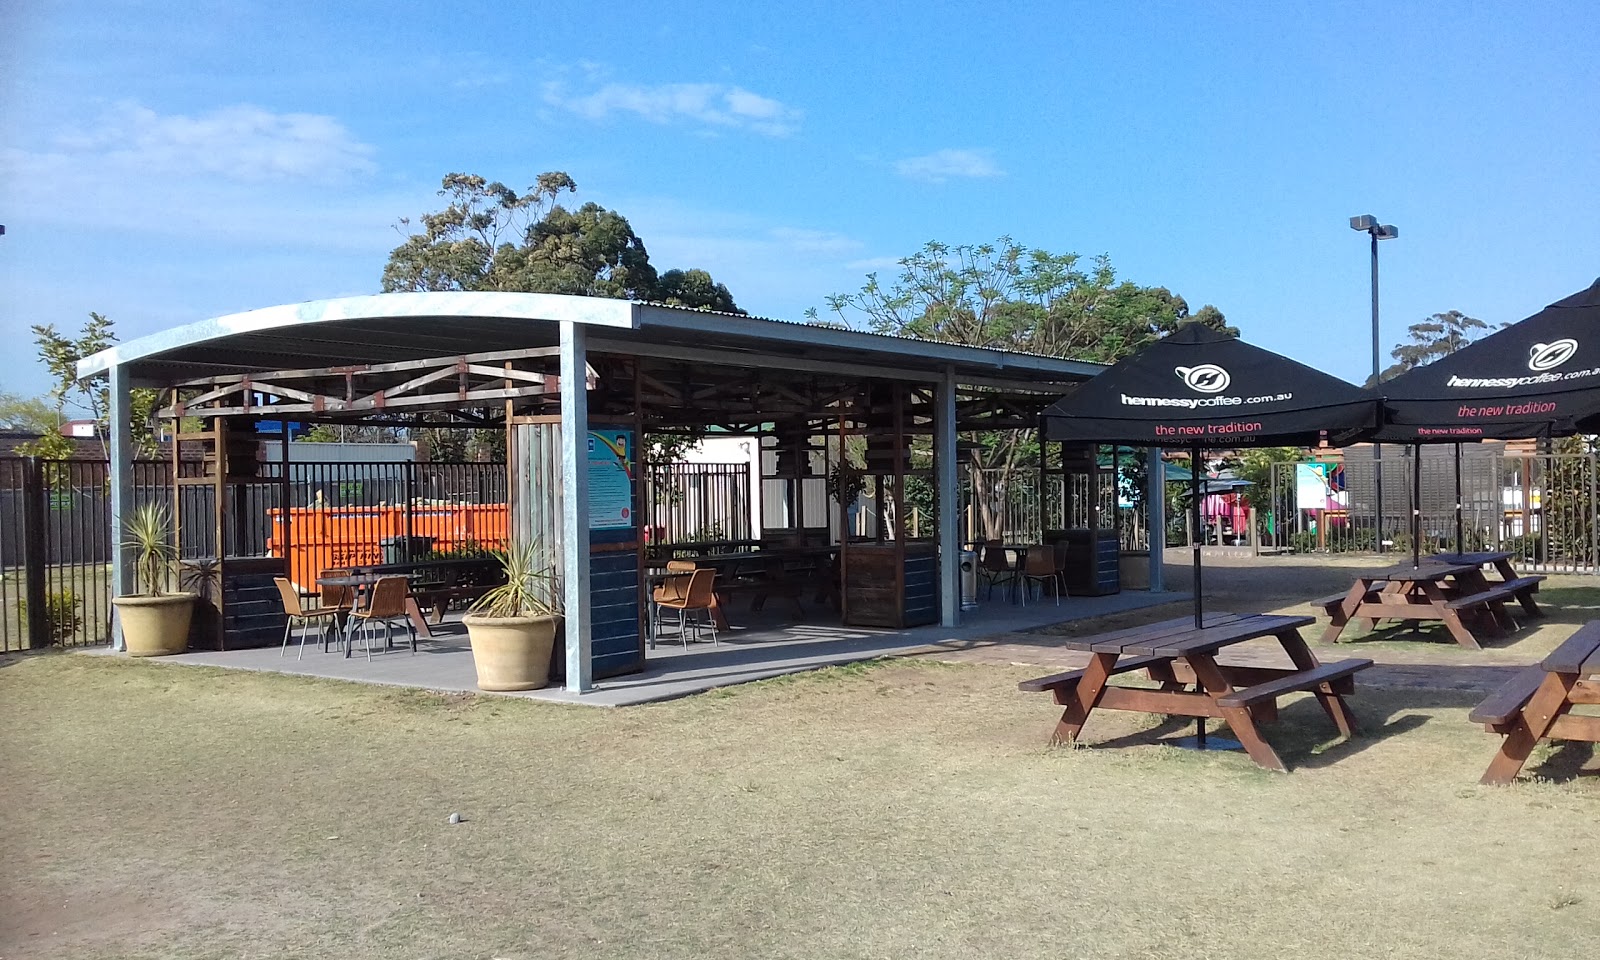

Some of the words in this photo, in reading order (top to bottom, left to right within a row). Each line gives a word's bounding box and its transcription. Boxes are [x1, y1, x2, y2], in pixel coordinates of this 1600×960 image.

[1458, 404, 1476, 417] the
[1478, 407, 1504, 417] new
[1506, 402, 1556, 415] tradition
[1155, 425, 1175, 436] the
[1178, 426, 1205, 435] new
[1207, 422, 1262, 434] tradition
[1418, 427, 1431, 435] the
